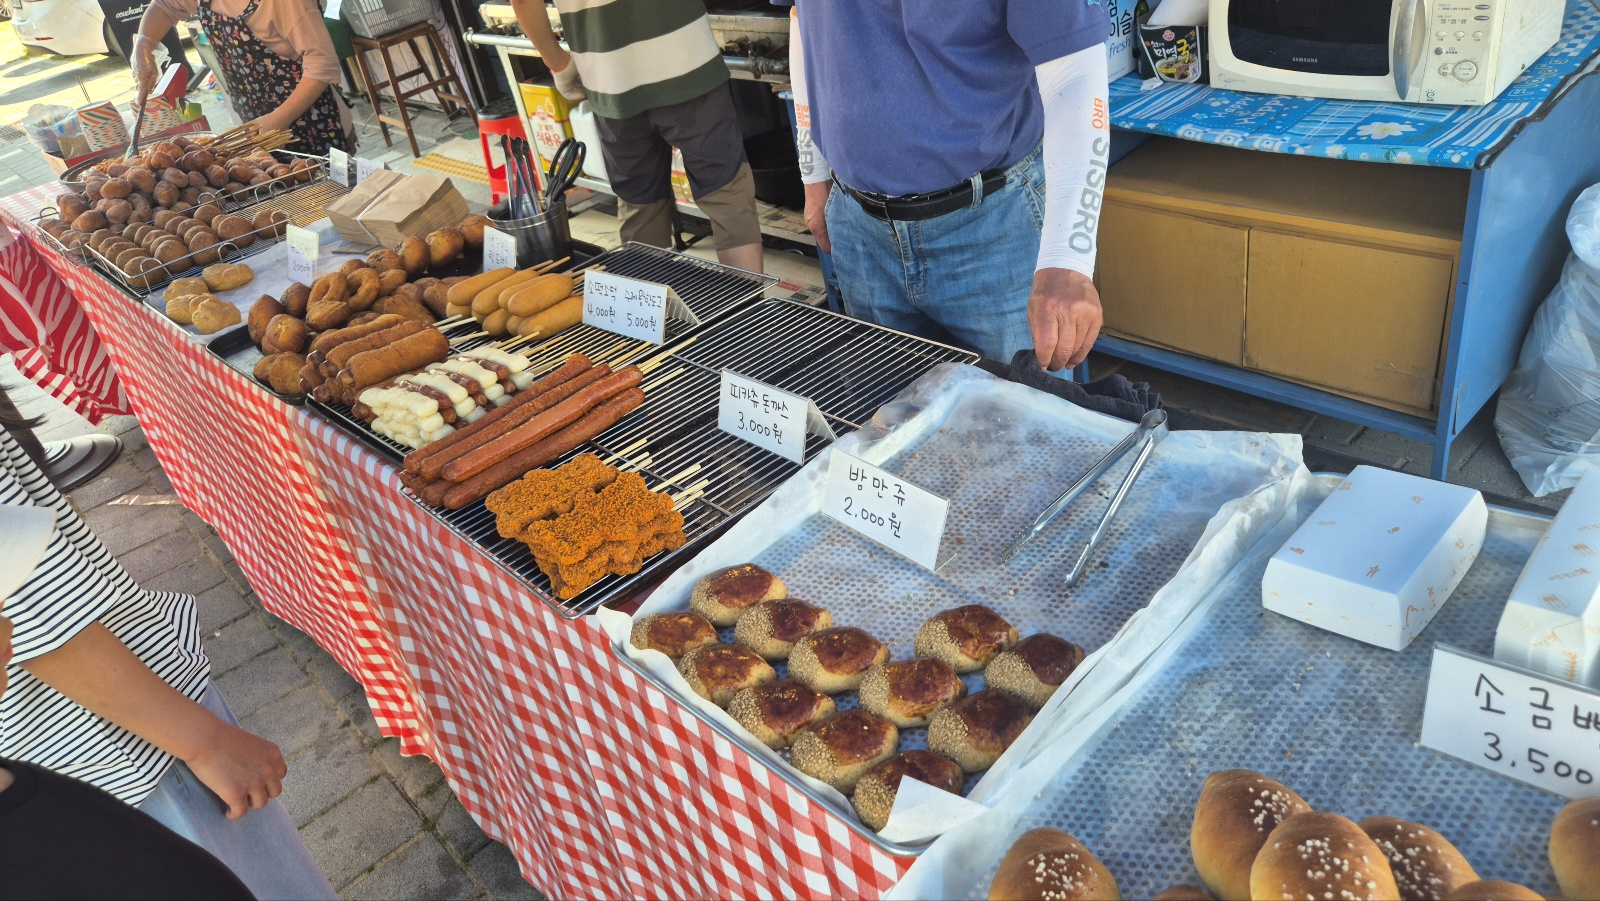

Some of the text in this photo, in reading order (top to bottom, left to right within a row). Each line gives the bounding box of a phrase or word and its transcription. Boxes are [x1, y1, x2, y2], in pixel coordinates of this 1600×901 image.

[1108, 37, 1132, 58] fresh
[1292, 56, 1319, 64] SAMSUNG
[1091, 97, 1104, 130] BRO
[626, 312, 657, 332] 5.000원
[738, 411, 783, 445] 3.000원
[844, 496, 902, 539] 2.000원
